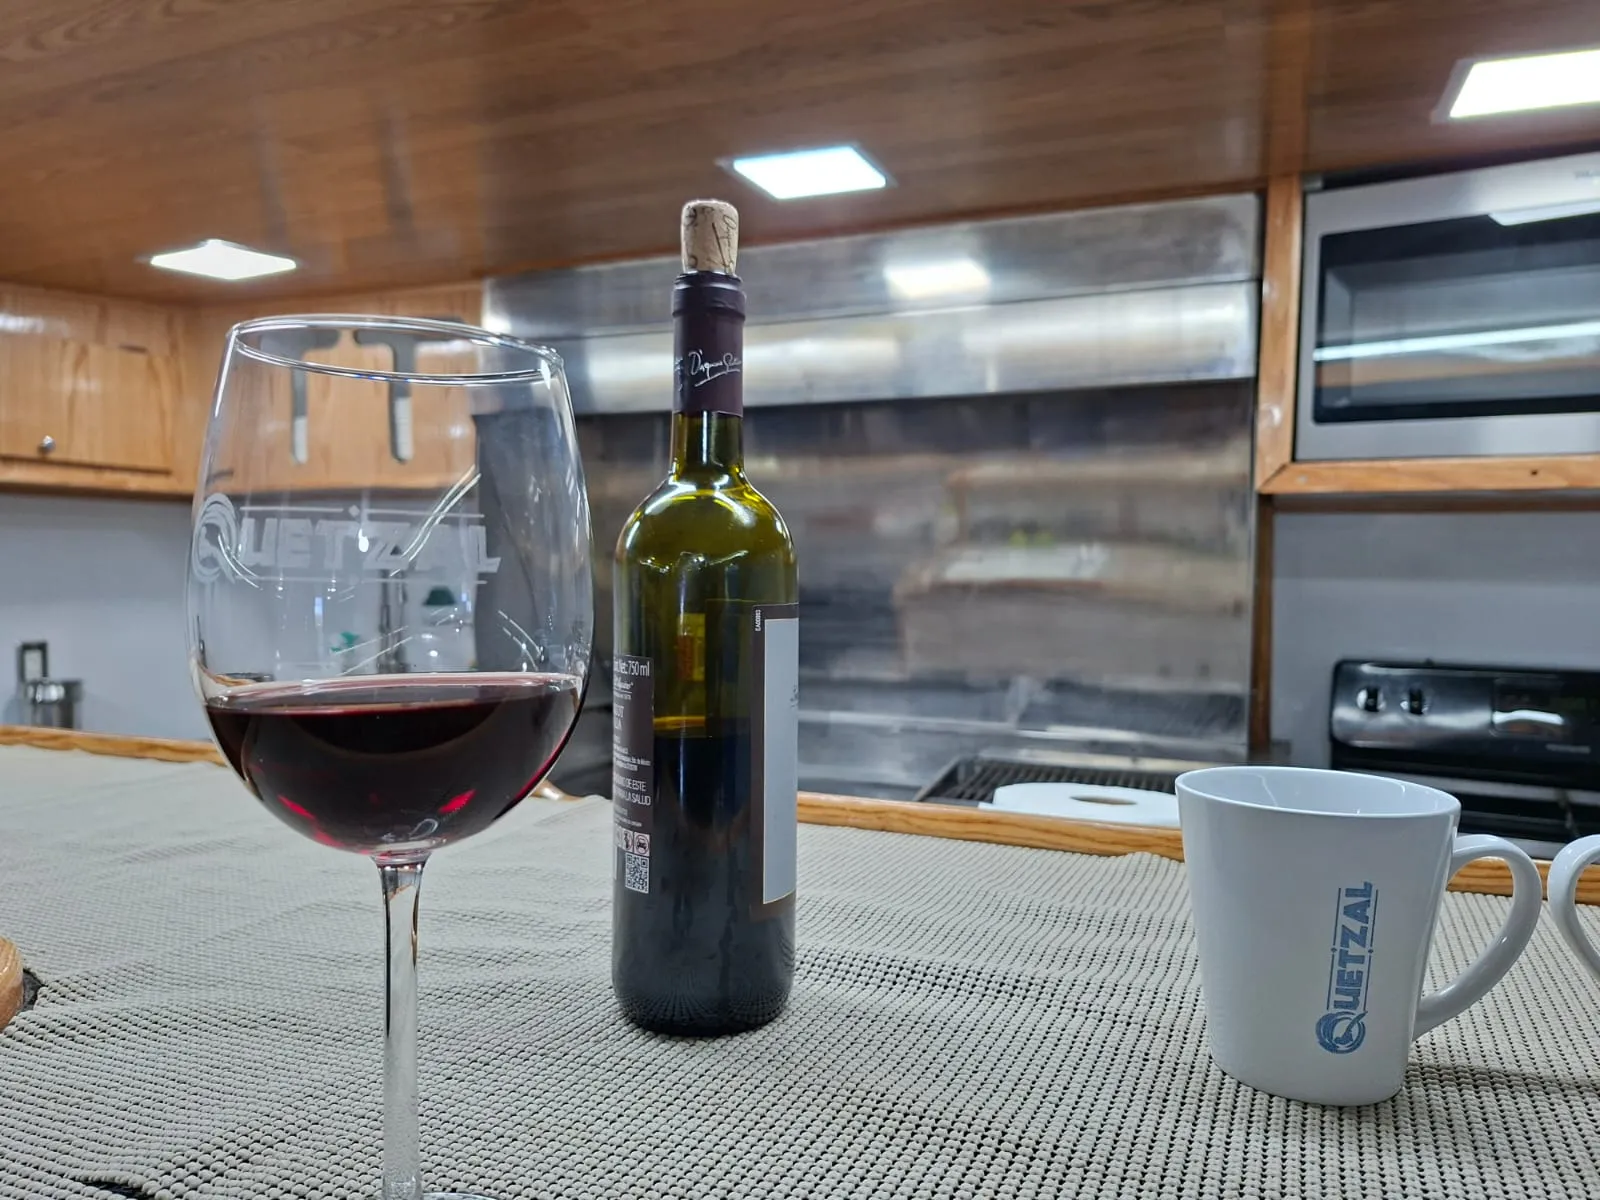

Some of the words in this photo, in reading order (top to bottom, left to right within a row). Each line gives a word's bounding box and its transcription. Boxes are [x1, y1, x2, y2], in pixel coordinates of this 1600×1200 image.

[191, 492, 501, 583] QUETZAL
[628, 660, 640, 676] 750
[640, 660, 650, 677] ml
[632, 779, 647, 792] ESTE
[631, 792, 651, 806] SALUD
[1315, 881, 1374, 1054] QUETZAL
